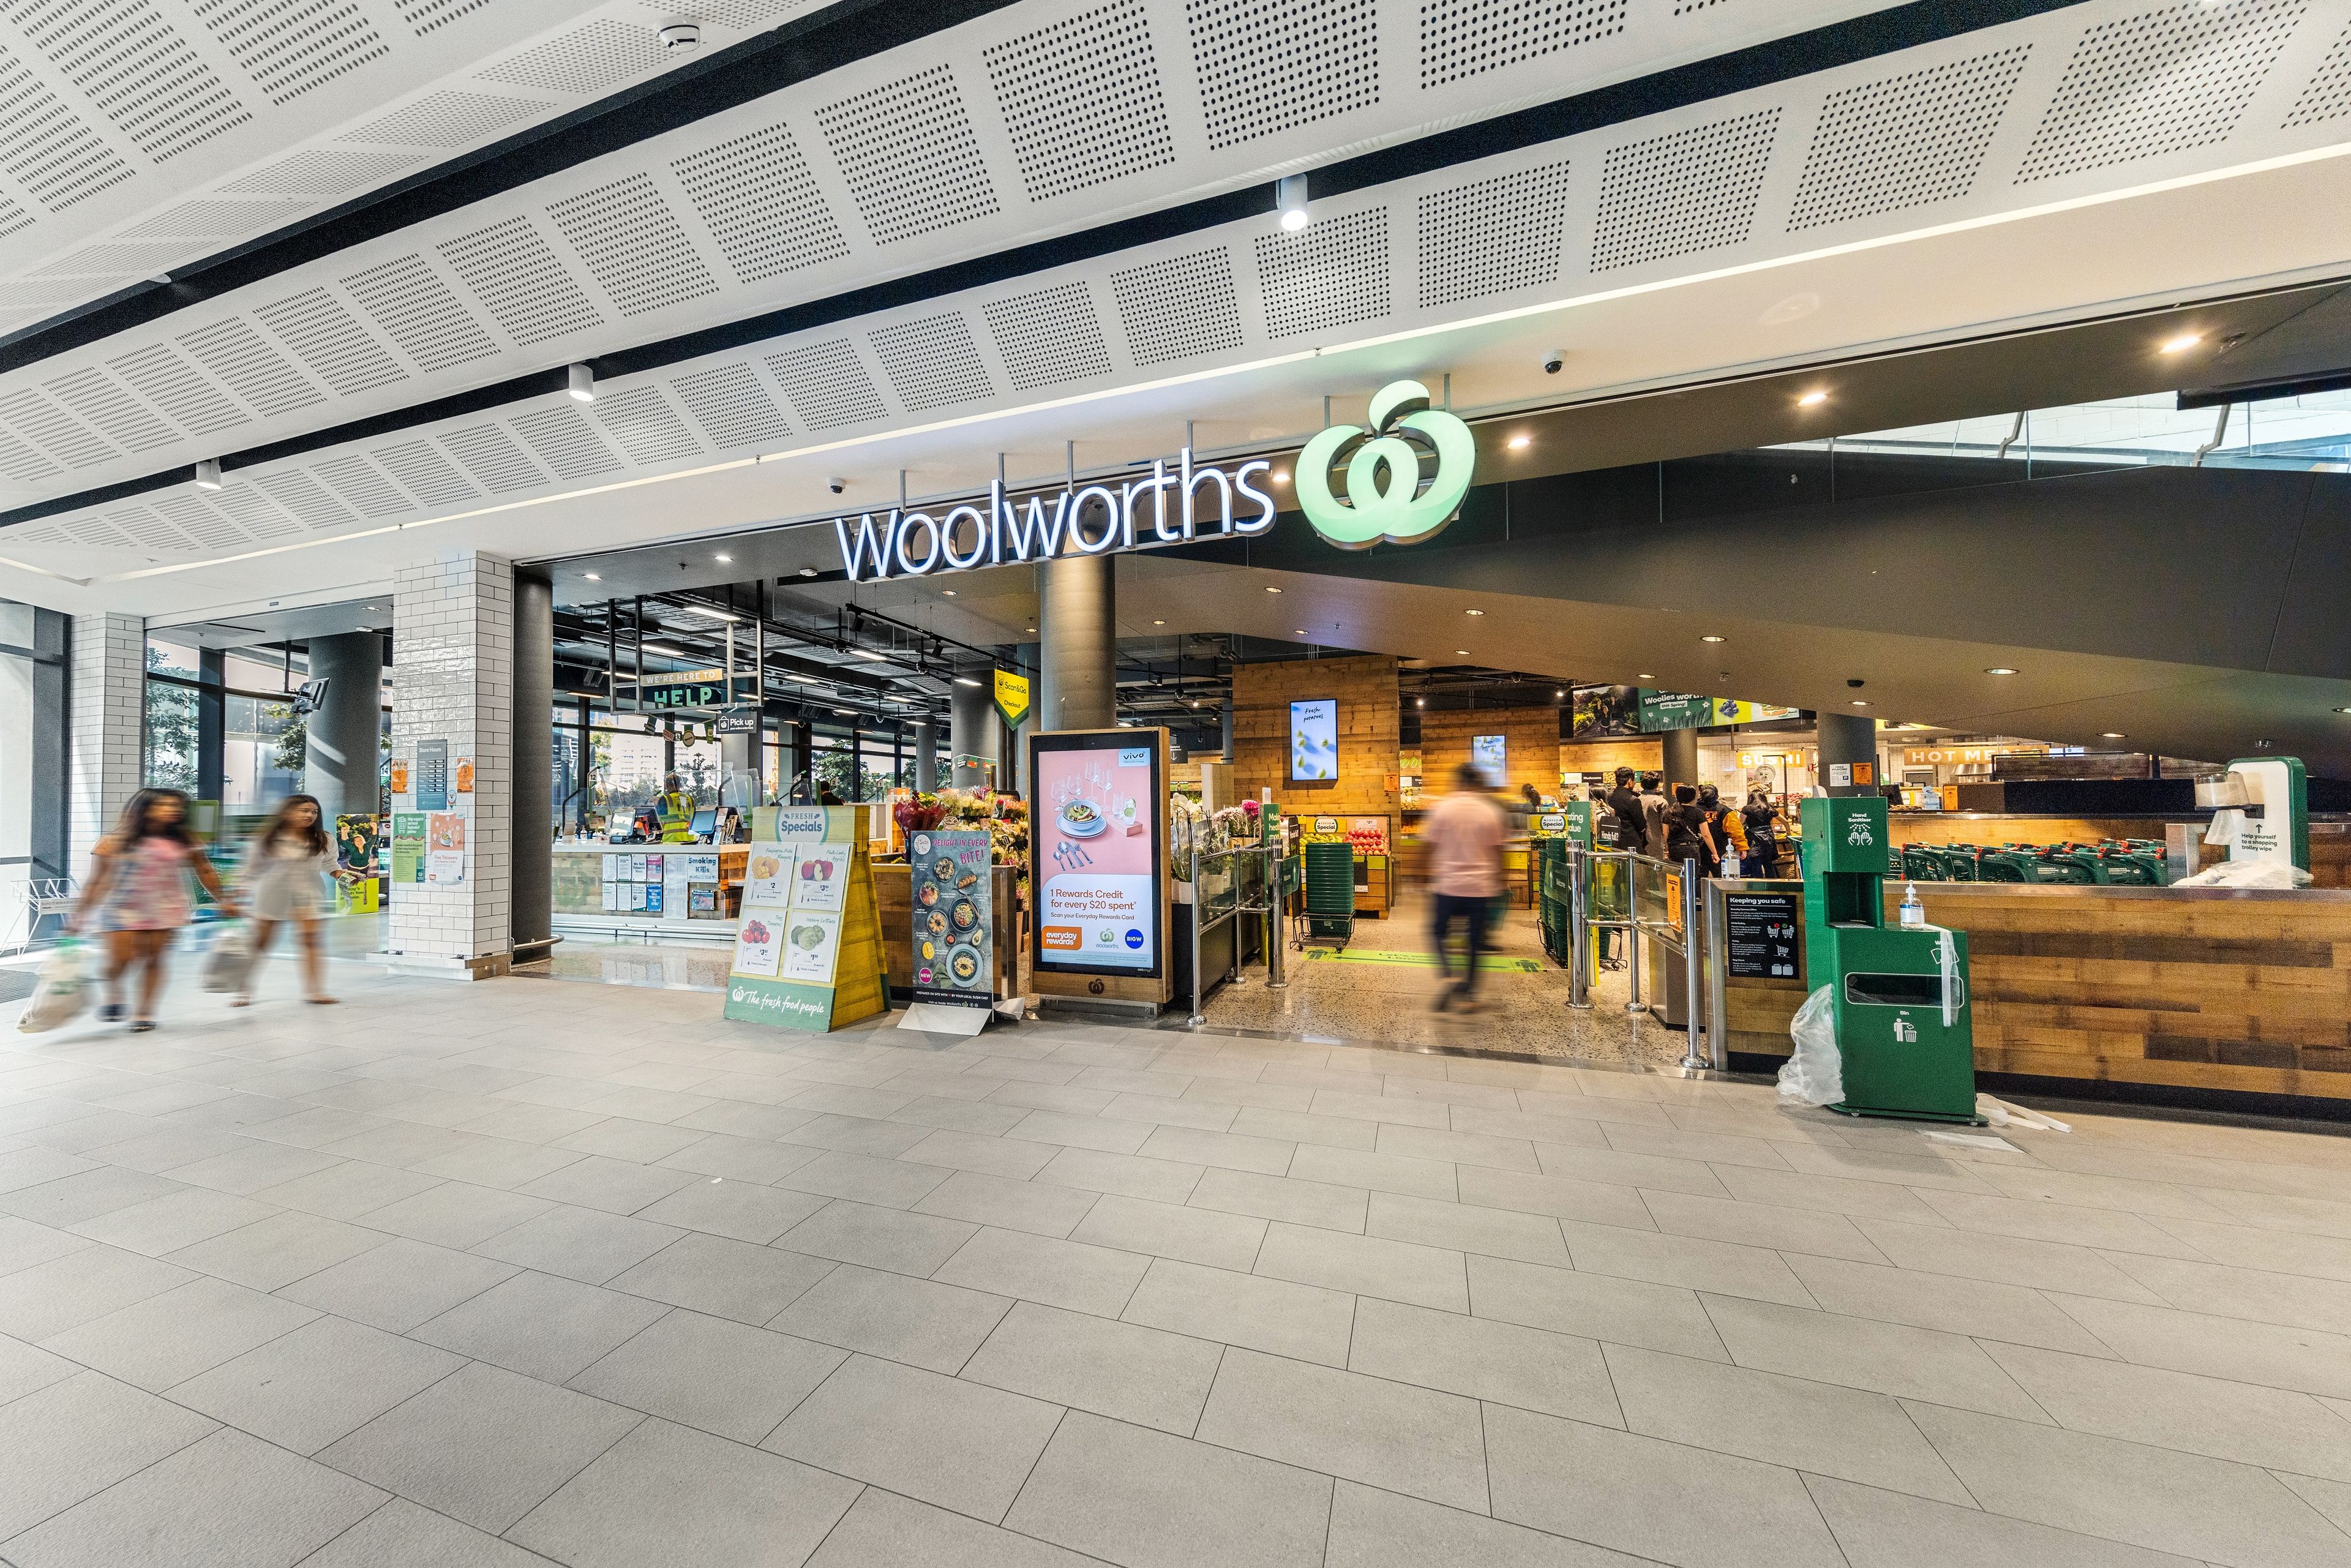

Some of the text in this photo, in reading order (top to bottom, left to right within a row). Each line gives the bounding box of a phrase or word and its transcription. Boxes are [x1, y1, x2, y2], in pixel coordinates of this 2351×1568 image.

[834, 448, 1273, 580] Woolworths
[647, 675, 674, 684] WE'RE
[1005, 681, 1027, 694] Scan&Go
[654, 687, 712, 709] HELP
[1644, 694, 1675, 705] Woolies
[1004, 700, 1021, 708] Checkout
[1303, 714, 1323, 722] potatoes
[1741, 753, 1801, 765] SUSHI
[1912, 751, 1956, 762] HOT
[1568, 812, 1583, 823] ating
[781, 821, 822, 835] Specials
[689, 857, 716, 866] Smoking
[960, 849, 984, 865] BITE!
[1056, 889, 1093, 898] Rewards
[1095, 890, 1123, 899] Credit
[1051, 899, 1062, 908] for
[1064, 902, 1087, 910] every
[1089, 901, 1106, 909] $20
[1046, 931, 1077, 940] everyday
[744, 990, 824, 1017] The fresh food people
